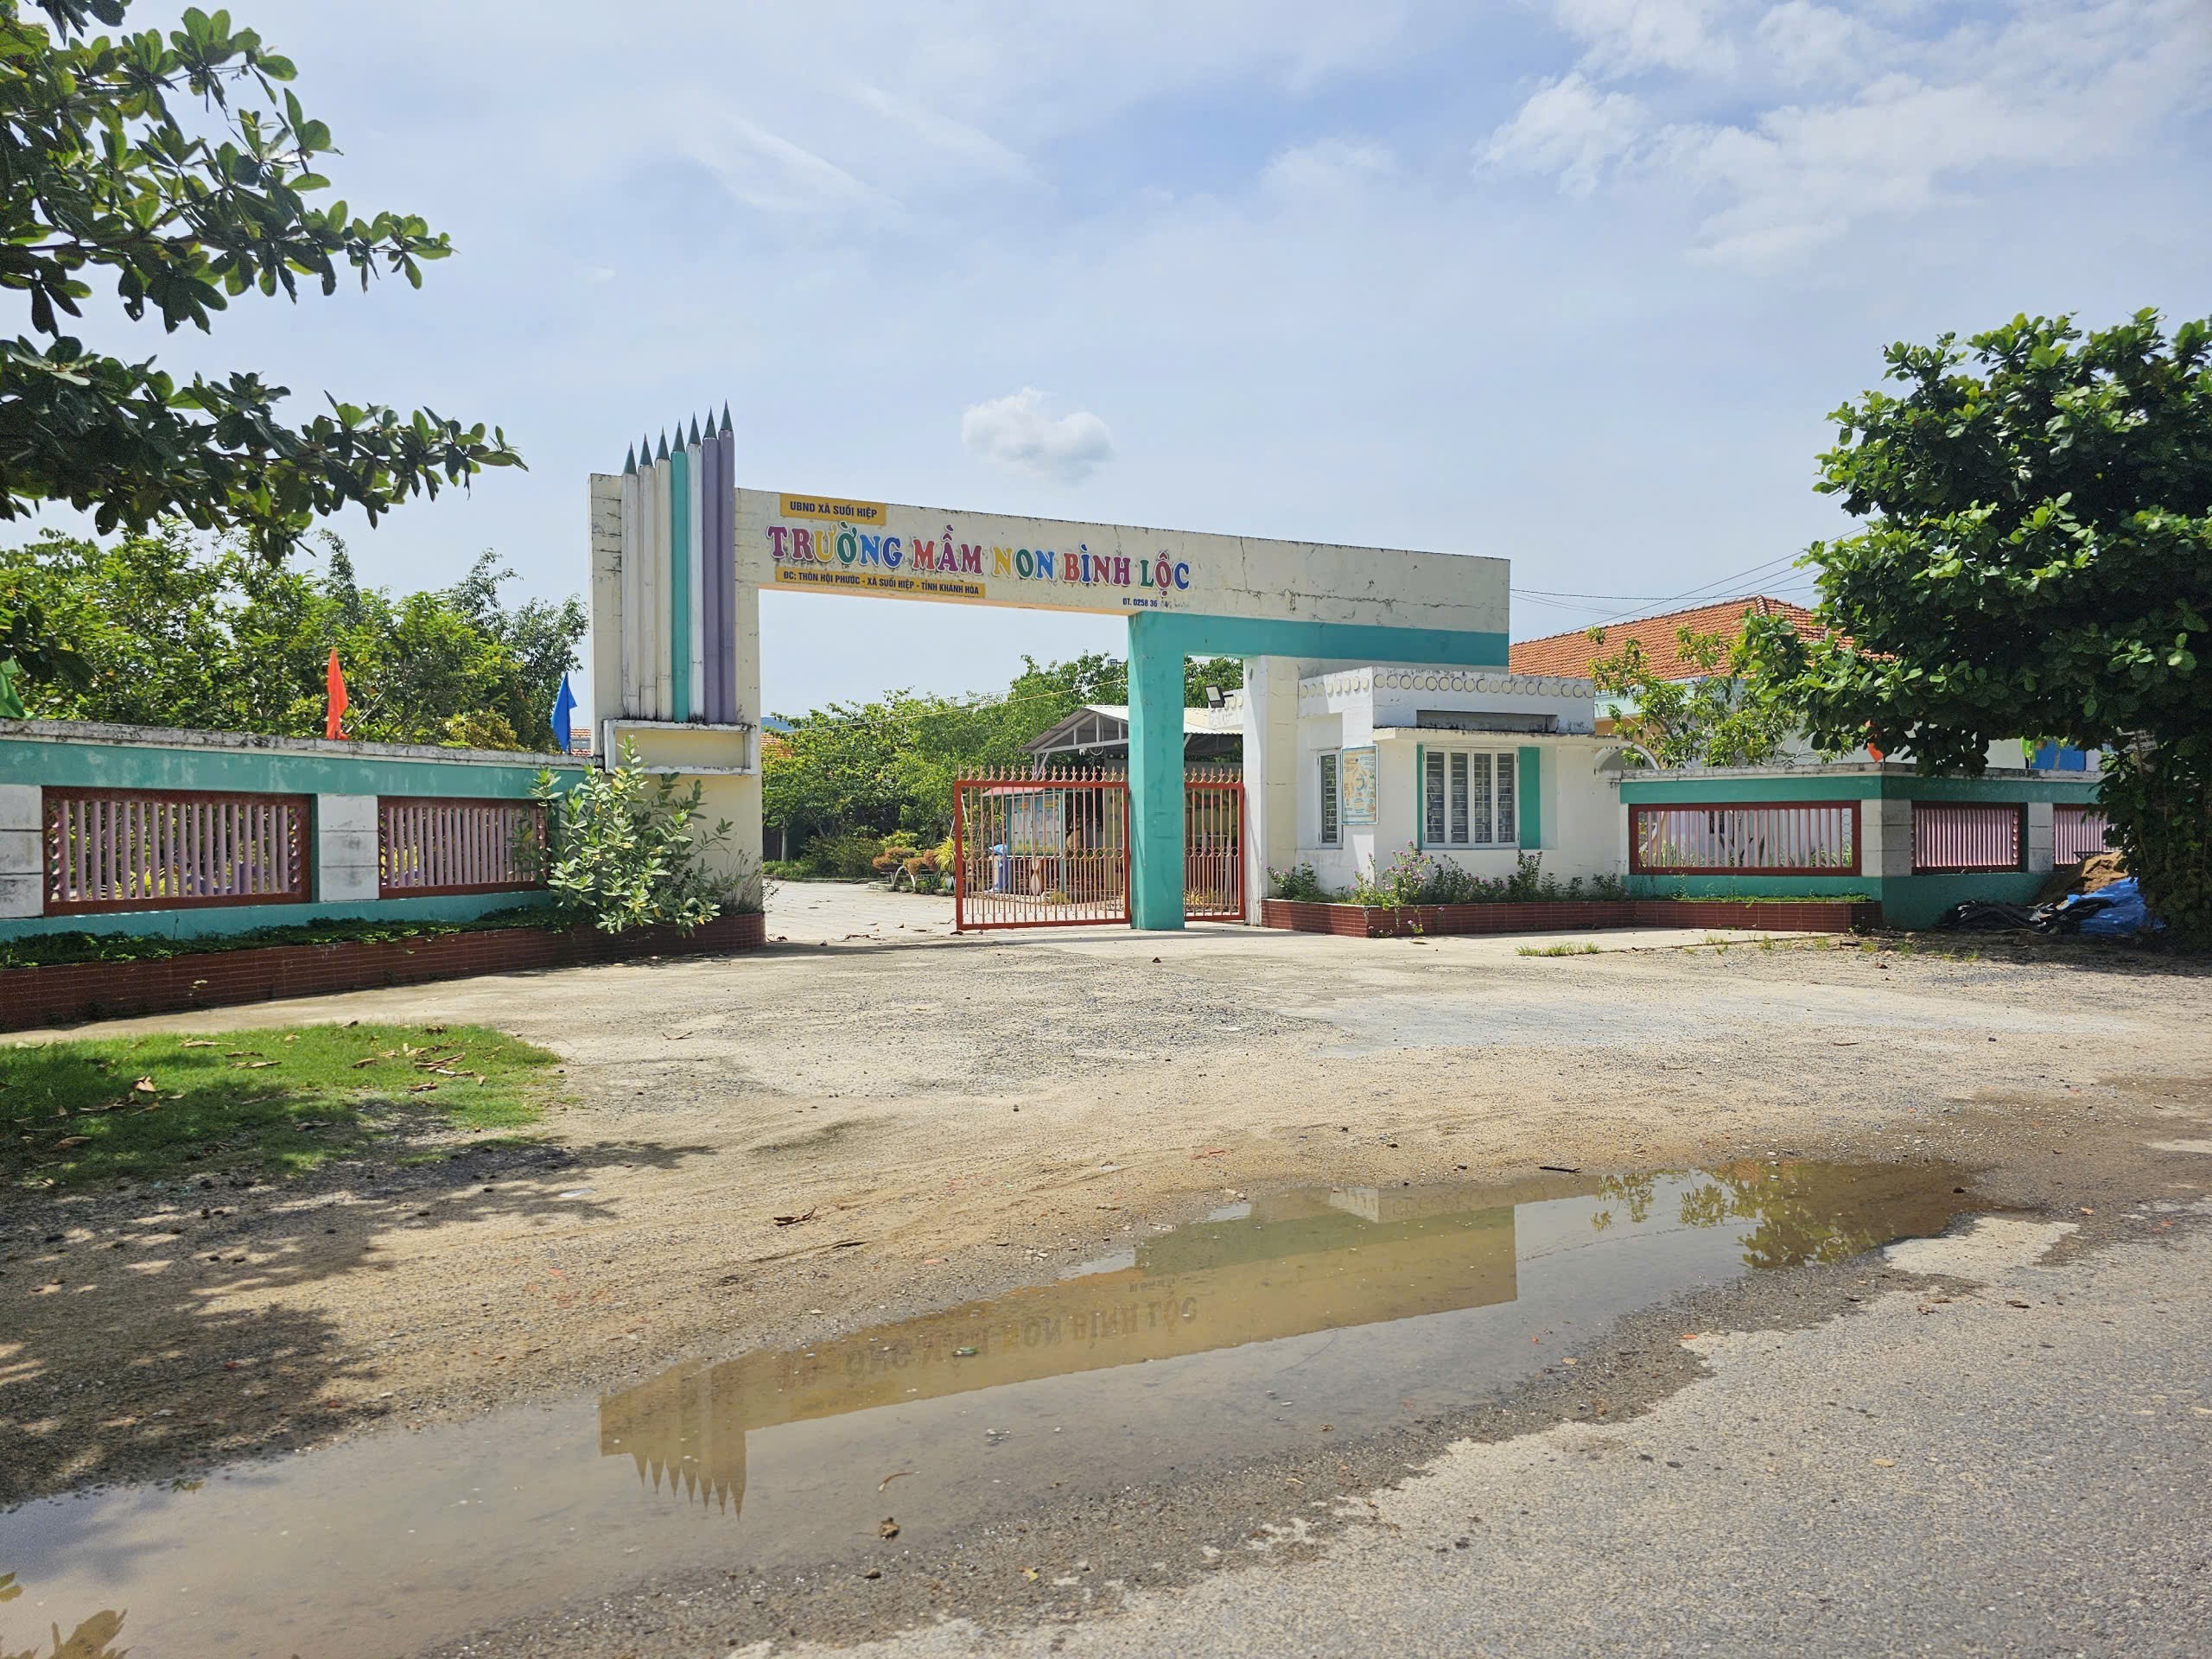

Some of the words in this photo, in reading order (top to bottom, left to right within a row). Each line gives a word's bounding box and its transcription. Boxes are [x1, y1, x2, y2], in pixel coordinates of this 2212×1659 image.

[790, 501, 815, 512] UBND
[818, 503, 830, 514] XÃ
[833, 504, 854, 516] SUỐI
[856, 507, 877, 519] HIỆP
[766, 521, 904, 568] TRƯỜNG
[912, 524, 982, 575] MẦM
[990, 546, 1055, 580] NON
[1062, 543, 1131, 587] BÌNH
[1139, 551, 1190, 597] LỘC
[798, 572, 818, 582] THÔN
[820, 573, 833, 584] HỘI
[835, 575, 860, 584] PHƯỚC
[867, 576, 877, 586] XÃ
[879, 577, 896, 588] SUỐI
[898, 579, 914, 591] HIỆP
[921, 580, 938, 591] TỈNH
[939, 582, 963, 593] KHÁNH
[965, 583, 979, 594] HÒA
